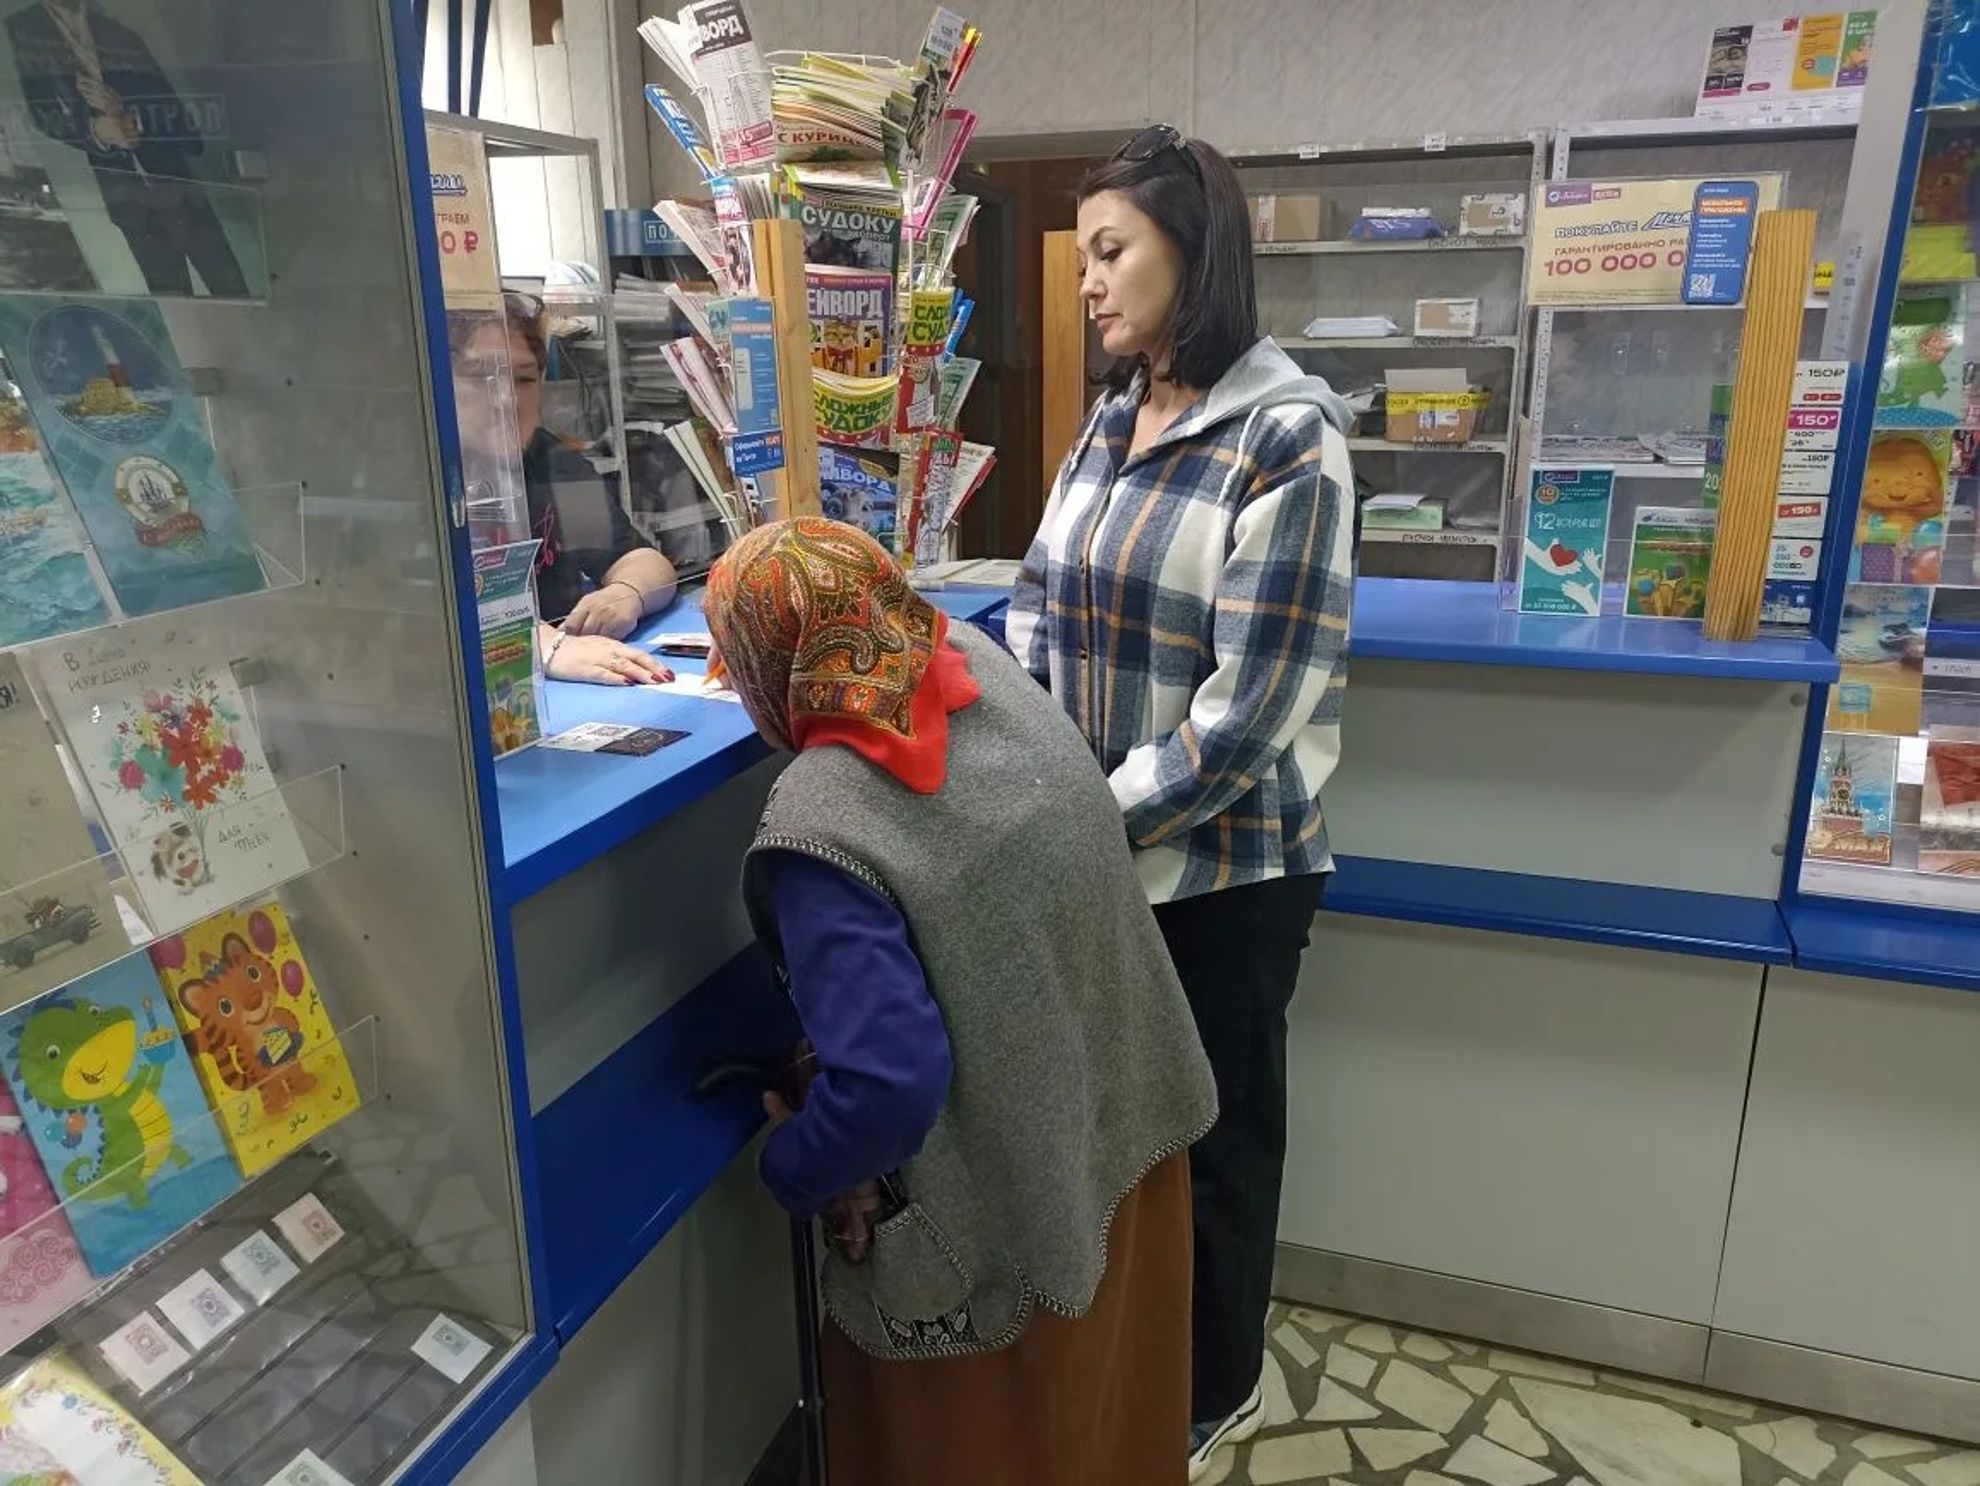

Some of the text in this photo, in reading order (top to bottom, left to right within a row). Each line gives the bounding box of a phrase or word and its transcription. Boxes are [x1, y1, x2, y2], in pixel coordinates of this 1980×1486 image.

[802, 205, 895, 233] СУДОКУ
[1555, 220, 1638, 239] ПОКУПАЙТЕ
[1555, 239, 1666, 256] ГАРАНТИРОВАННО
[1545, 258, 1592, 276] 100
[1601, 252, 1657, 272] 000
